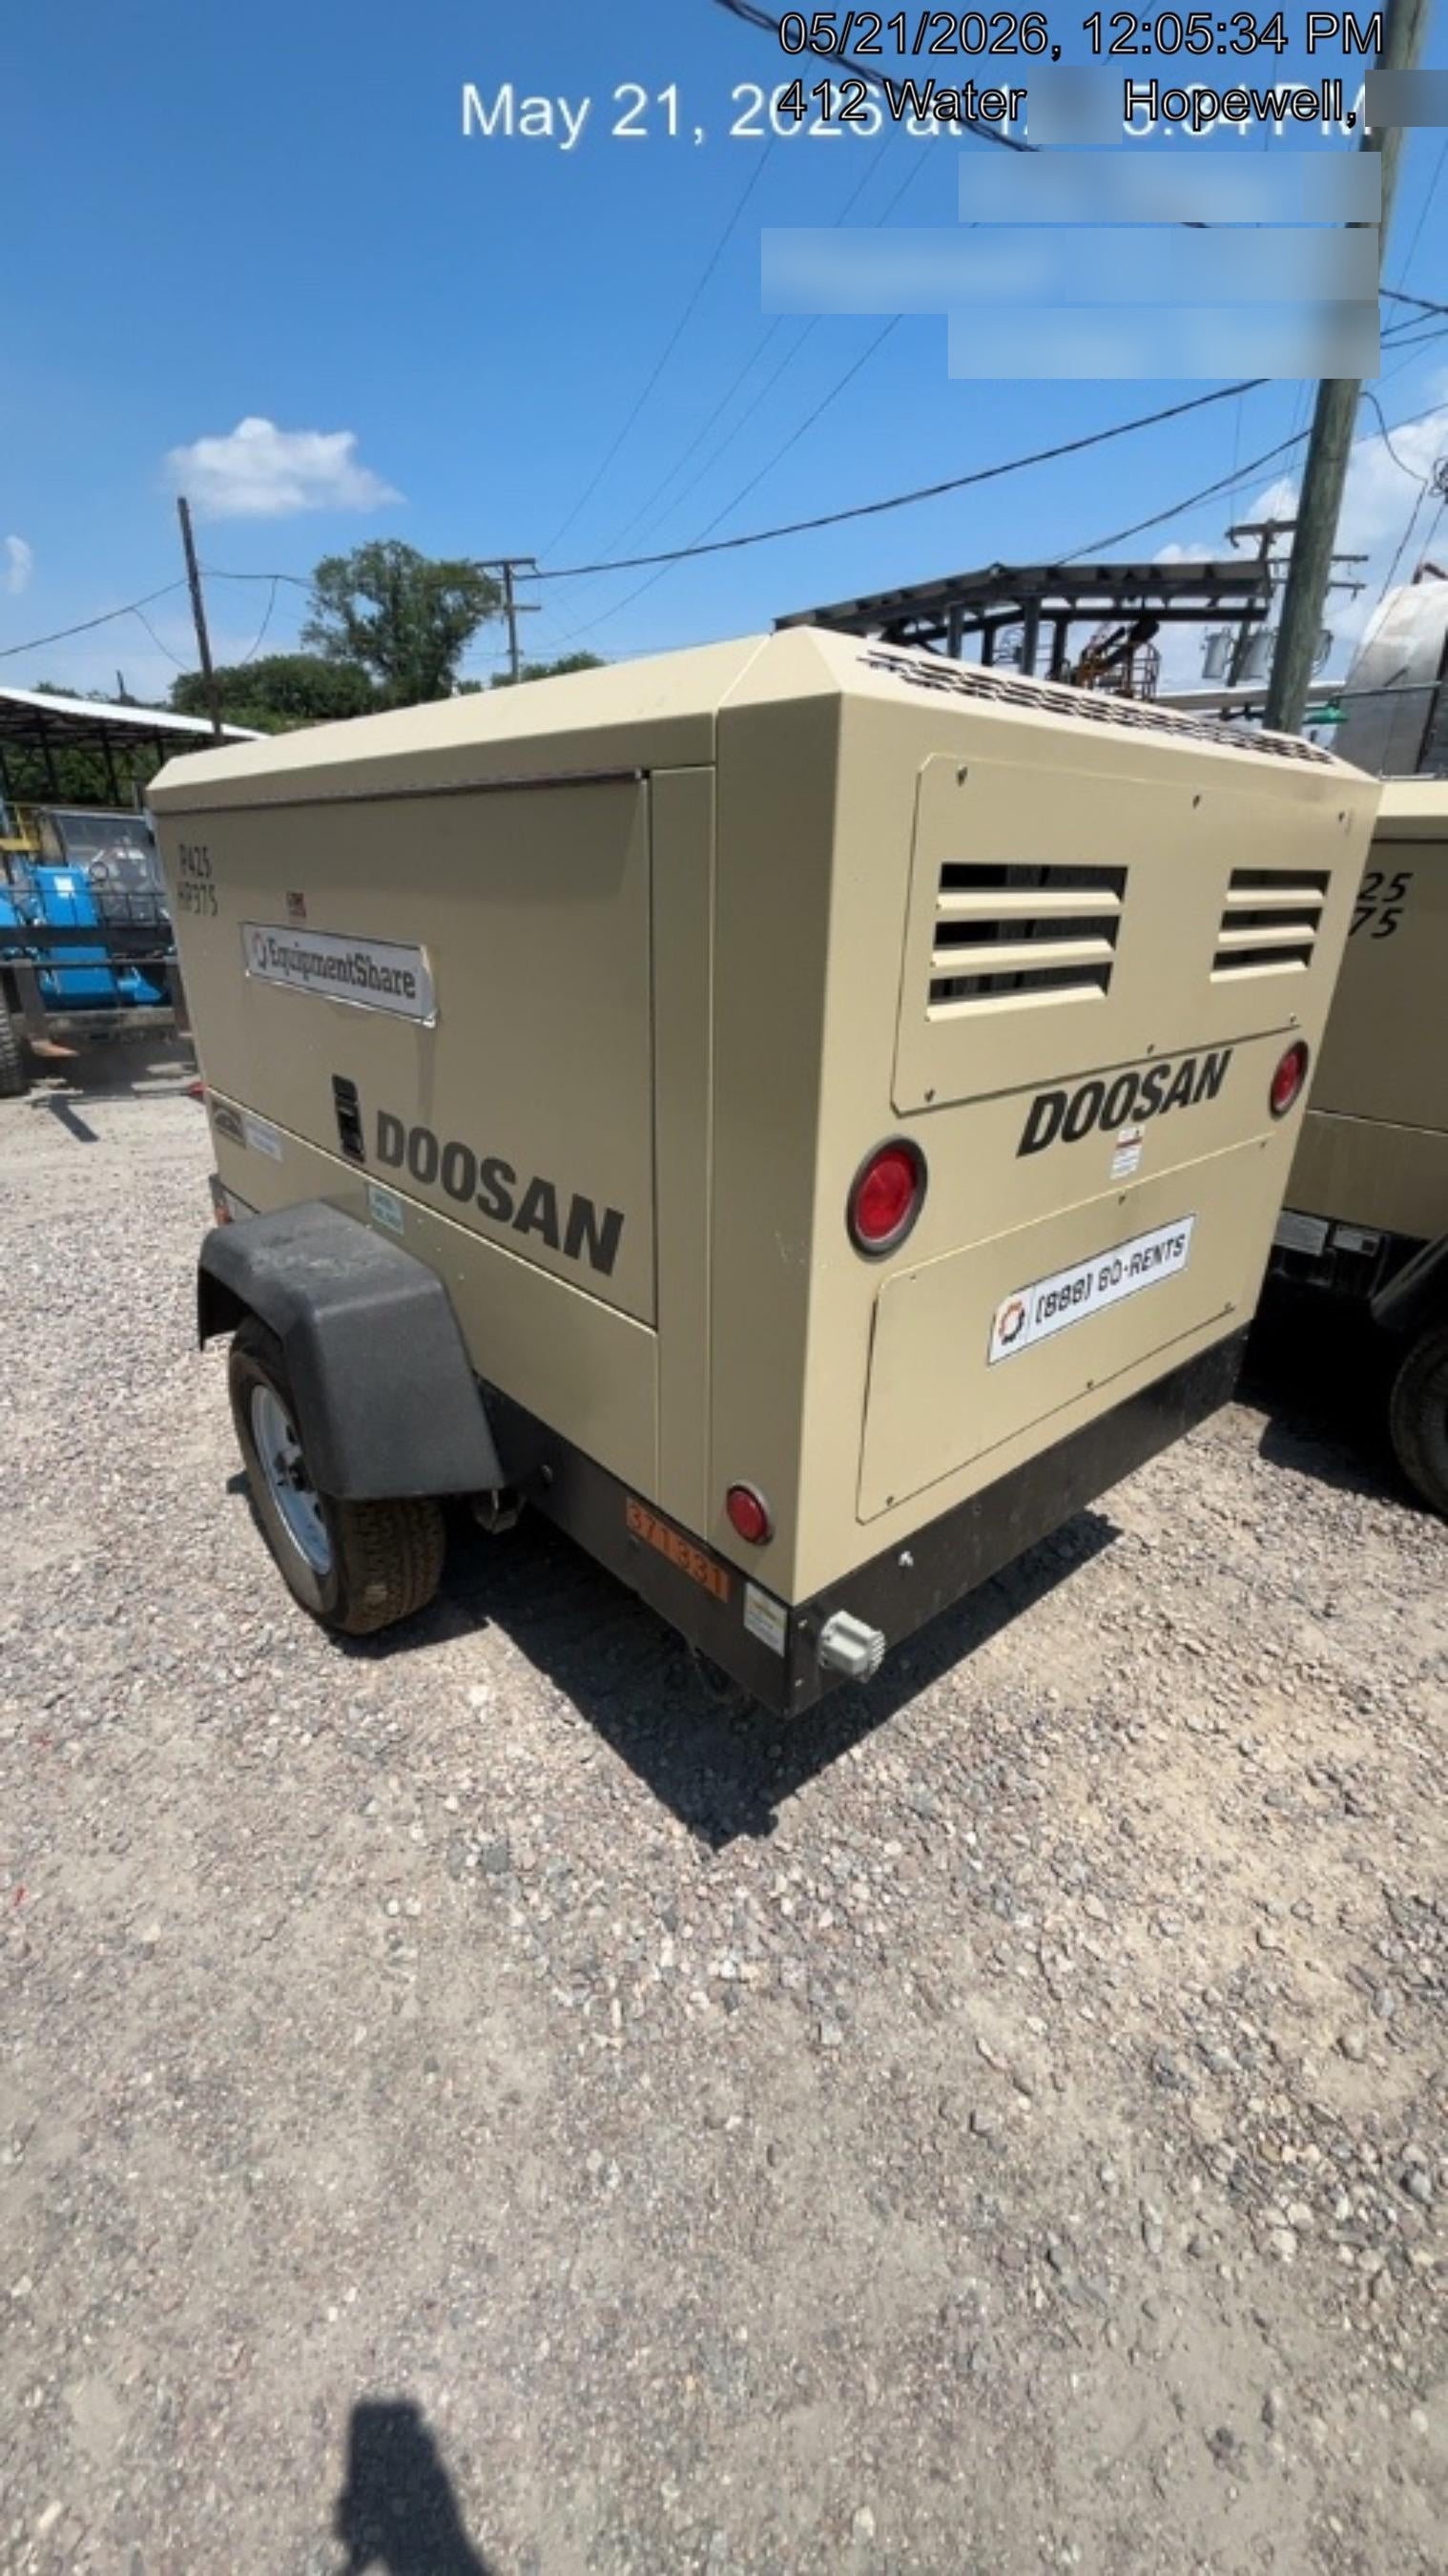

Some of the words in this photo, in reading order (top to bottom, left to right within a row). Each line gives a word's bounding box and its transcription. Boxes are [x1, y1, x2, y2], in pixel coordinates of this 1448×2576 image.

[178, 843, 213, 879] P425
[266, 936, 416, 1000] EquipmentShare
[1016, 1048, 1233, 1158] DOOSAN
[377, 1110, 625, 1277] DOOSAN
